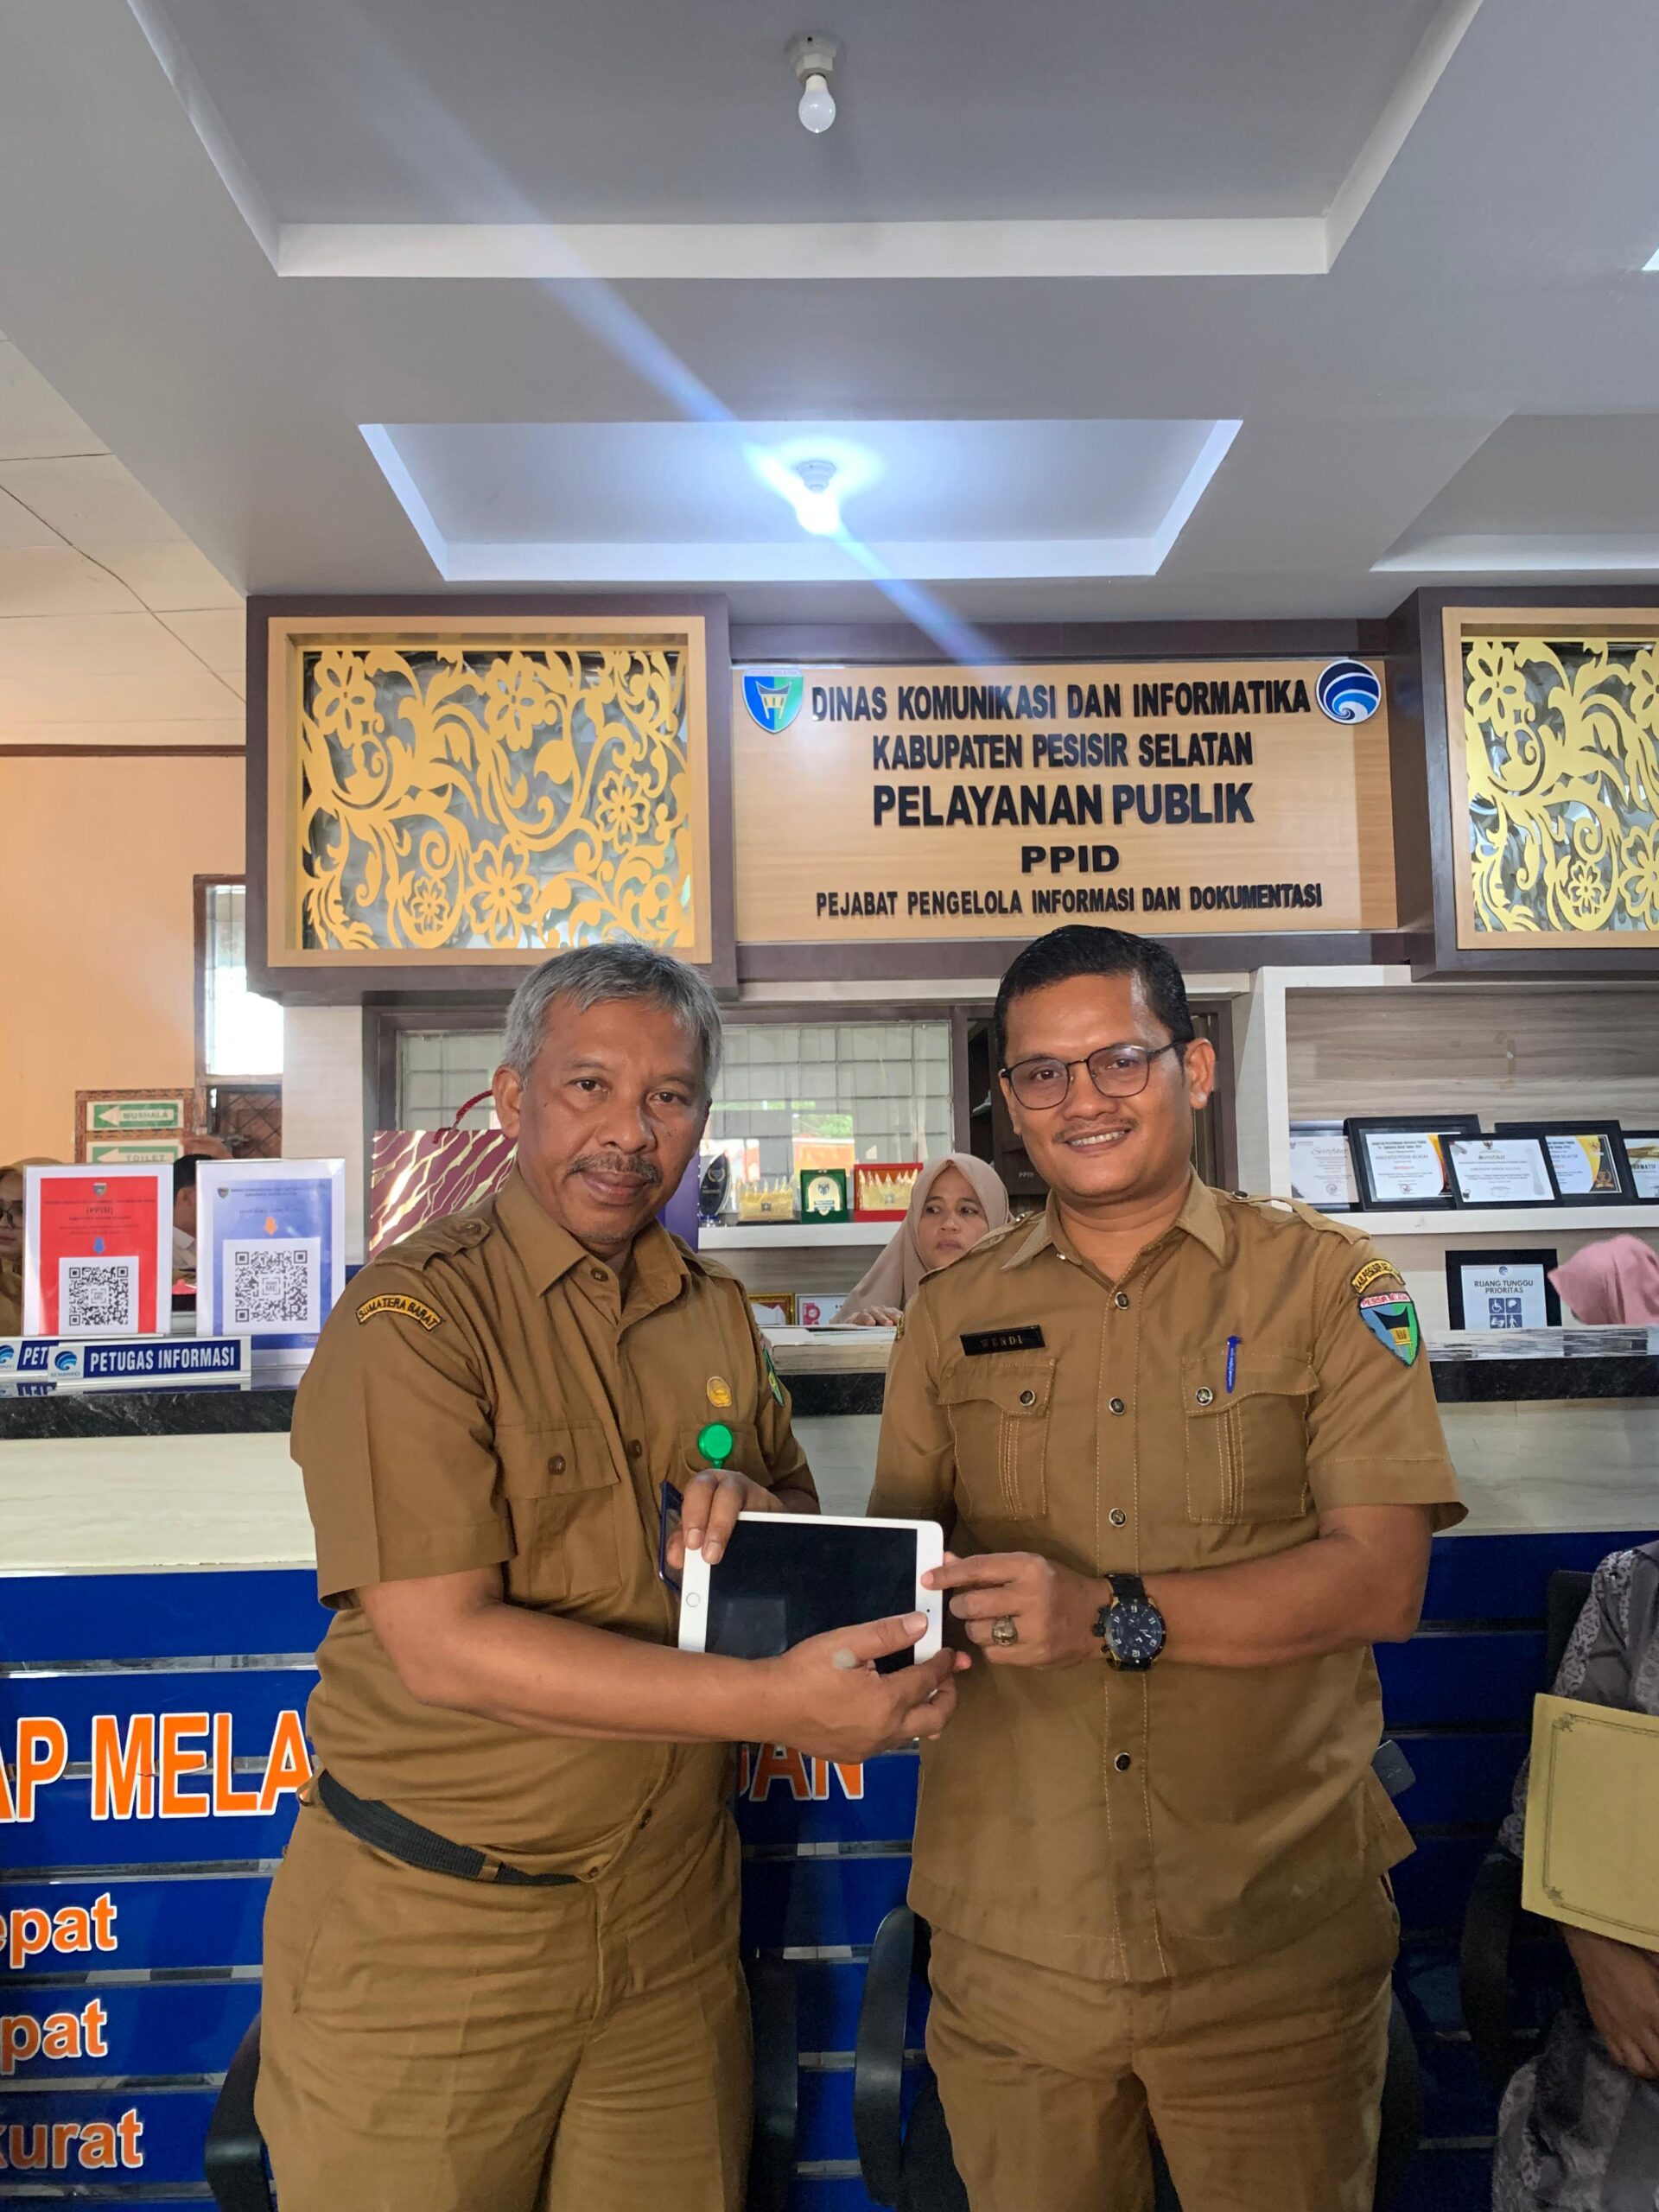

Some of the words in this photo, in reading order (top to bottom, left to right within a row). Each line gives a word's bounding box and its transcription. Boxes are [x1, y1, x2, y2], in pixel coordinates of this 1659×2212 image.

[812, 686, 888, 722] DINAS
[898, 684, 1057, 721] KOMUNIKASI
[1067, 683, 1122, 720] DAN
[1133, 679, 1312, 718] INFORMATIKA
[873, 734, 1023, 771] KABUPATEN
[1032, 733, 1129, 769] PESISIR
[1138, 731, 1254, 768] SELATAN
[874, 784, 1104, 827] PELAYANAN
[1112, 782, 1255, 825] PUBLIK
[1020, 844, 1121, 874] PPID
[817, 891, 899, 918] PEJABAT
[907, 890, 1023, 916] PENGELOLA
[1032, 887, 1135, 914] INFORMASI
[1141, 886, 1182, 912] DAN
[1189, 883, 1323, 911] DOKUMENTASI
[359, 1298, 407, 1319] SUMATERA
[407, 1301, 438, 1326] BARAT
[90, 1350, 154, 1372] PETUGAS
[158, 1346, 235, 1370] INFORMASI
[91, 1710, 314, 1821] MELA
[0, 1891, 118, 1969] pat
[0, 2108, 144, 2171] urat
